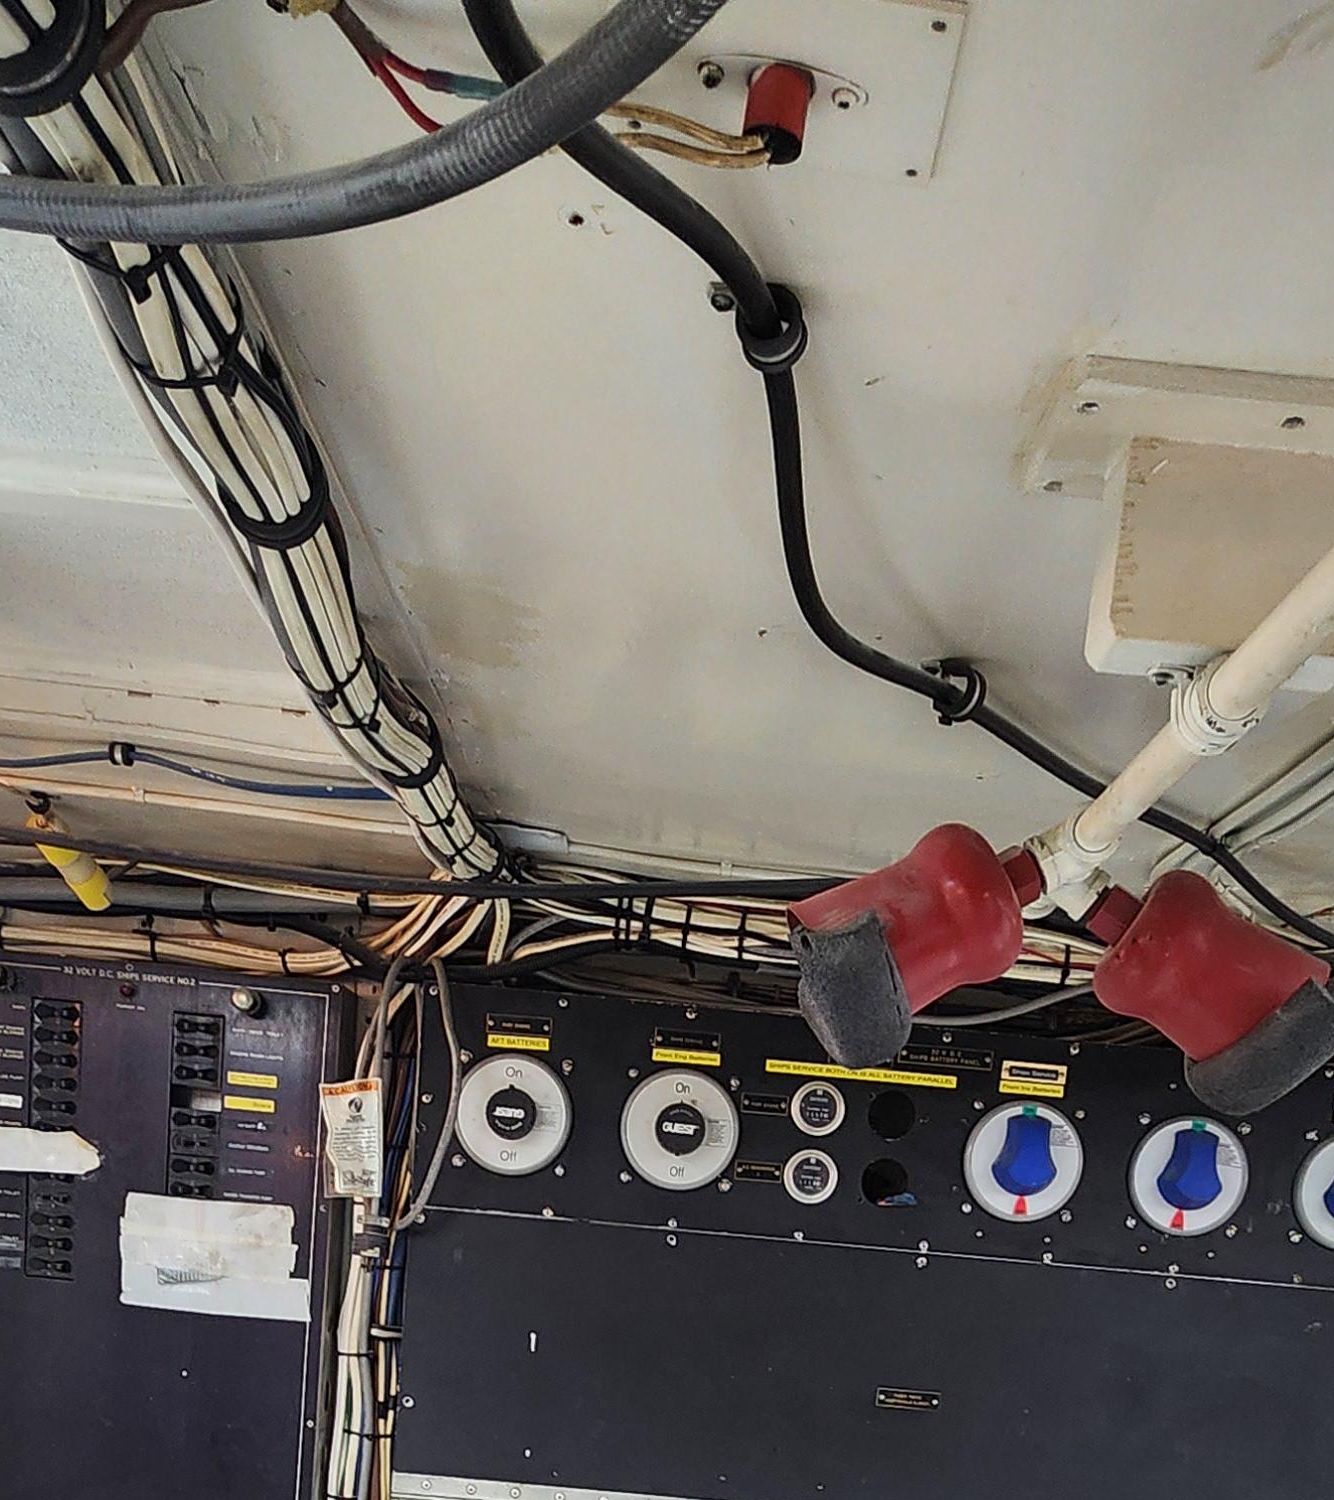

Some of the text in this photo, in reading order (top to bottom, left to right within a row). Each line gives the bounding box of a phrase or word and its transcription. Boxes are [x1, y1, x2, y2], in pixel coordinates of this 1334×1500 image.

[63, 966, 74, 975] 32
[76, 967, 97, 977] VOLT
[142, 973, 176, 985] SERVICE
[507, 1038, 547, 1048] BATTERIES
[930, 1055, 958, 1064] BATTERY
[505, 1066, 523, 1079] On
[769, 1062, 791, 1070] SHIPS
[792, 1064, 824, 1074] SERVICE
[826, 1067, 846, 1076] BOTH
[883, 1073, 917, 1082] BATTERY
[917, 1076, 955, 1085] PARALLEL
[675, 1082, 691, 1094] On
[662, 1121, 700, 1136] GUEST
[500, 1150, 517, 1162] Off
[669, 1166, 685, 1178] Off
